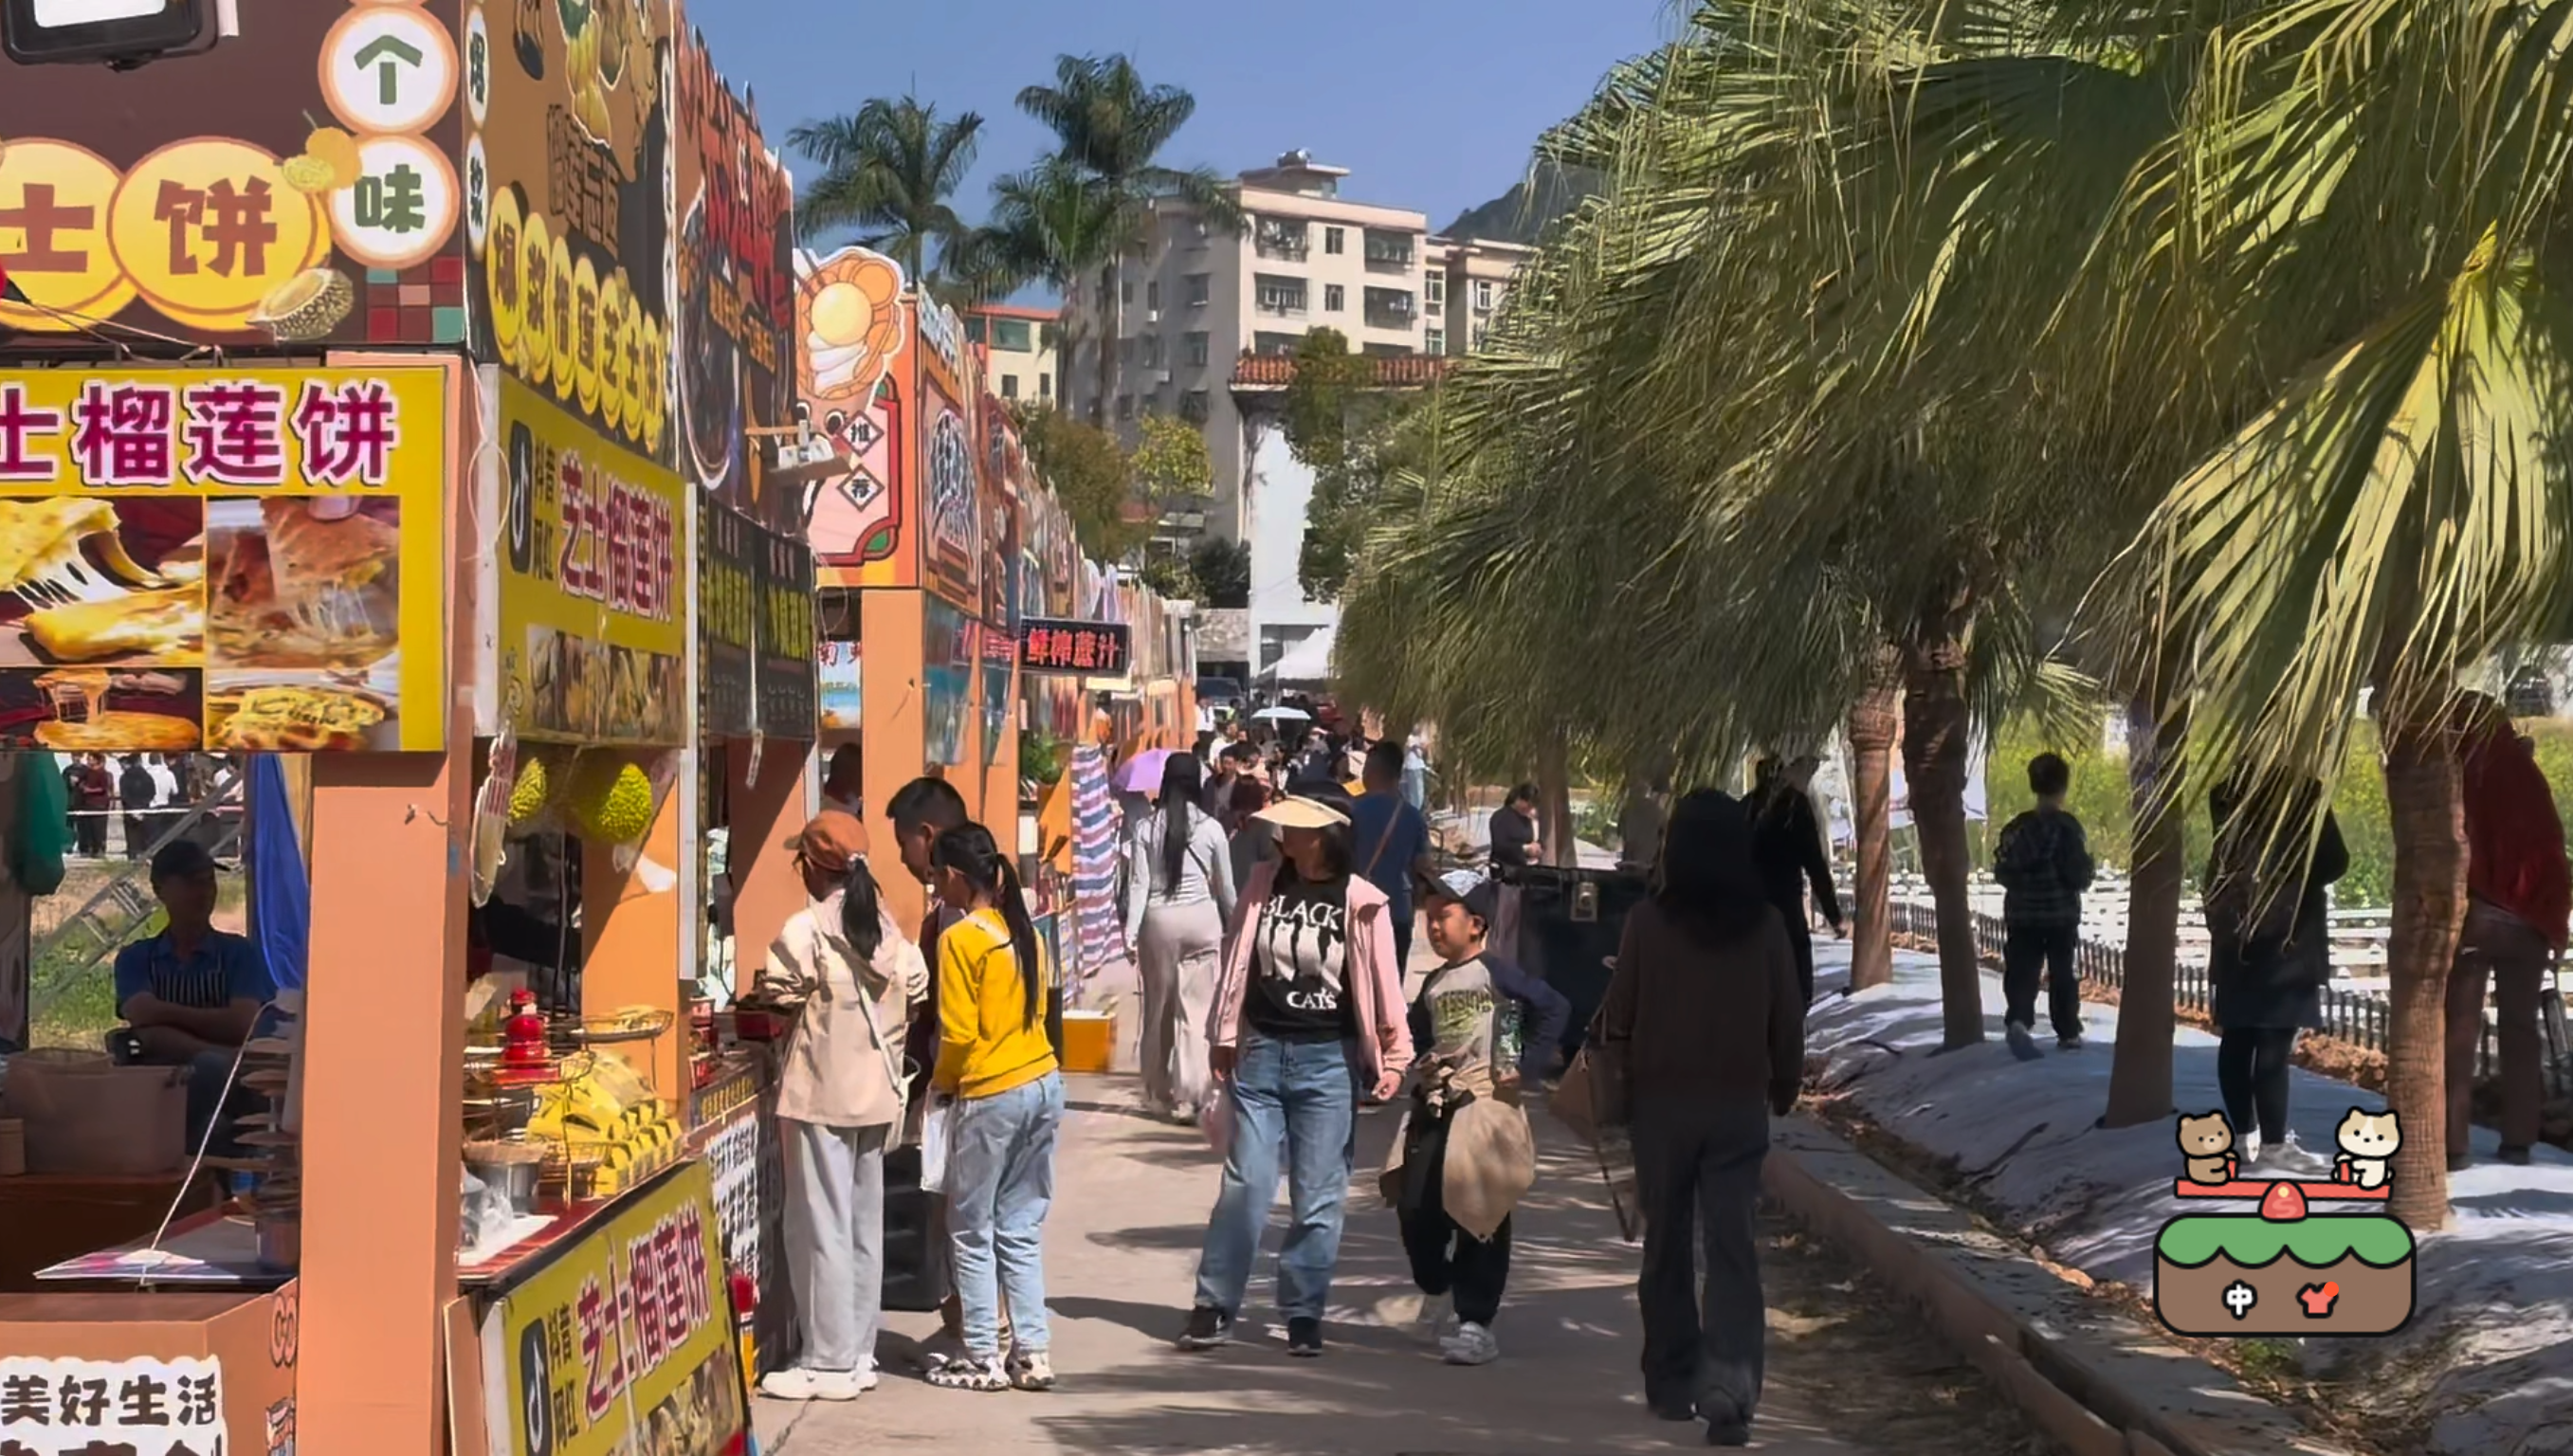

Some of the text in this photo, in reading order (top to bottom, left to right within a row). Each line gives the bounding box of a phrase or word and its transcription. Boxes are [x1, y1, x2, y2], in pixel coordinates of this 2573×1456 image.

[0, 173, 278, 278] 士饼
[0, 381, 396, 482] 士榴莲饼
[850, 423, 870, 499] 推荐
[559, 449, 674, 624] 芝士榴莲饼
[1027, 628, 1120, 668] 鲜榨蔗汁
[1262, 894, 1343, 931] BLACK
[546, 1301, 573, 1373] 抖音
[576, 1200, 711, 1422] 芝士榴莲饼
[1, 1374, 217, 1427] 美好生活
